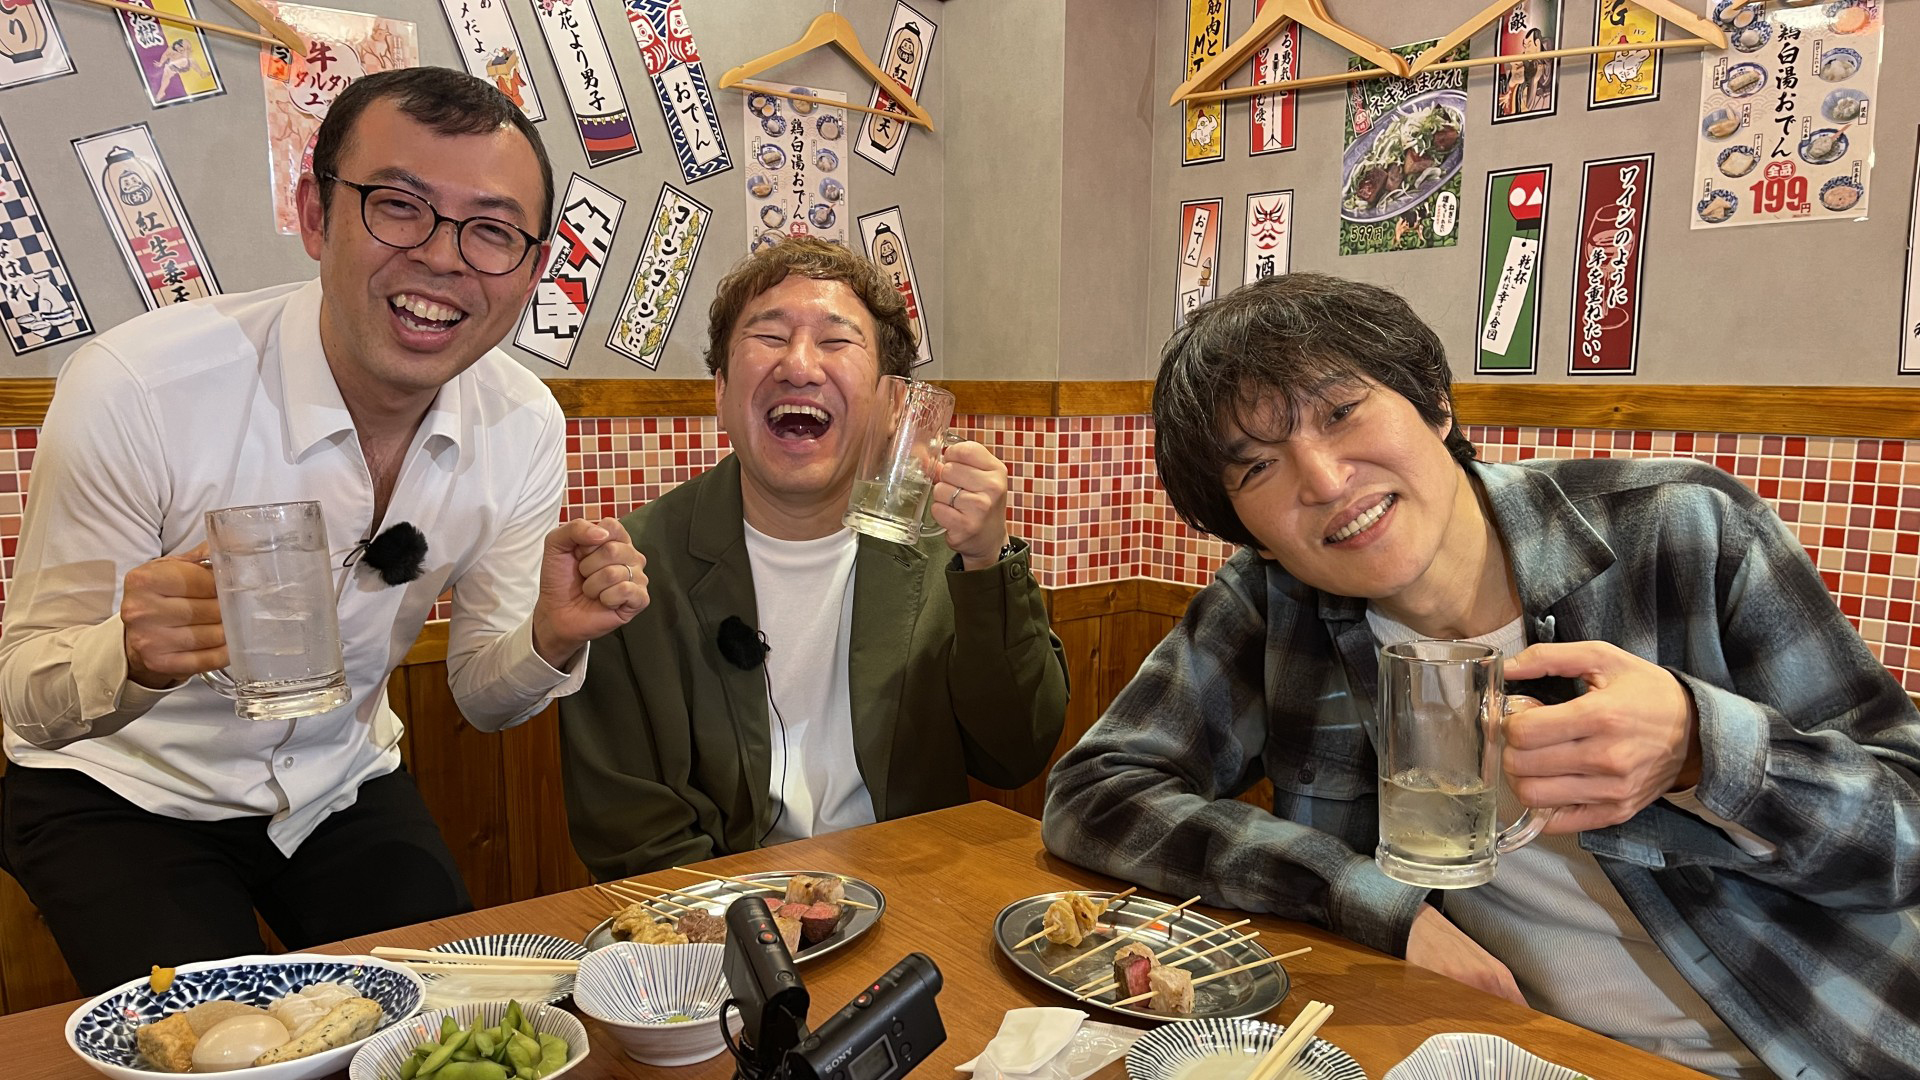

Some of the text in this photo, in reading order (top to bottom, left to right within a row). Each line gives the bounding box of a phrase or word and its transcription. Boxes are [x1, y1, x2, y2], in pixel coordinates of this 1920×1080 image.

[306, 41, 337, 72] 牛
[1206, 0, 1221, 56] 筋肉と
[558, 8, 605, 111] 花より男子
[674, 81, 711, 150] おでん
[1370, 68, 1462, 116] ネギ塩まみれ
[790, 118, 805, 219] 鶏白湯おでん
[1767, 163, 1793, 177] 全品
[1188, 214, 1206, 260] おでん
[1351, 226, 1383, 241] 599円
[1607, 166, 1639, 308] ワインのように
[533, 196, 612, 338] 牛串
[1486, 265, 1514, 341] それは幸せの合図
[1582, 247, 1606, 363] 年を重ねたい。
[825, 1047, 853, 1073] SONY
